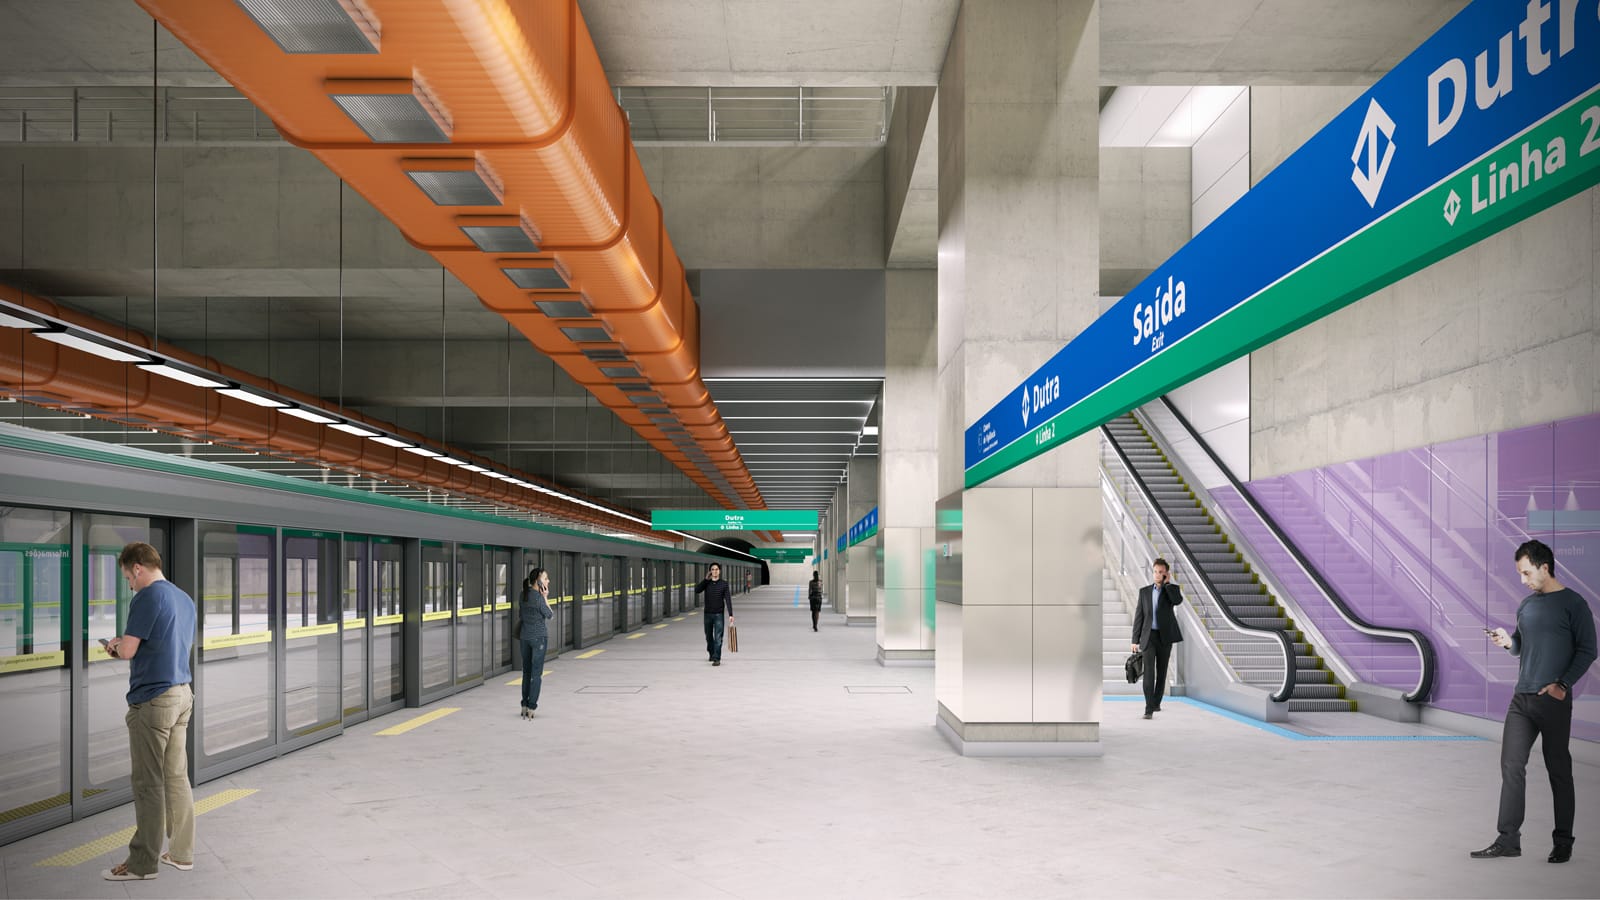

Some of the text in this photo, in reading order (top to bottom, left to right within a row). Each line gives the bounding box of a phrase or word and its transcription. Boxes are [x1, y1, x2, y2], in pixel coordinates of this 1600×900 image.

[1427, 0, 1600, 147] Dutr
[1471, 105, 1600, 215] Linha 2
[1132, 275, 1186, 346] Saída
[1151, 333, 1165, 353] Exit
[1033, 375, 1060, 414] Dutra
[1039, 422, 1056, 445] Linha 2
